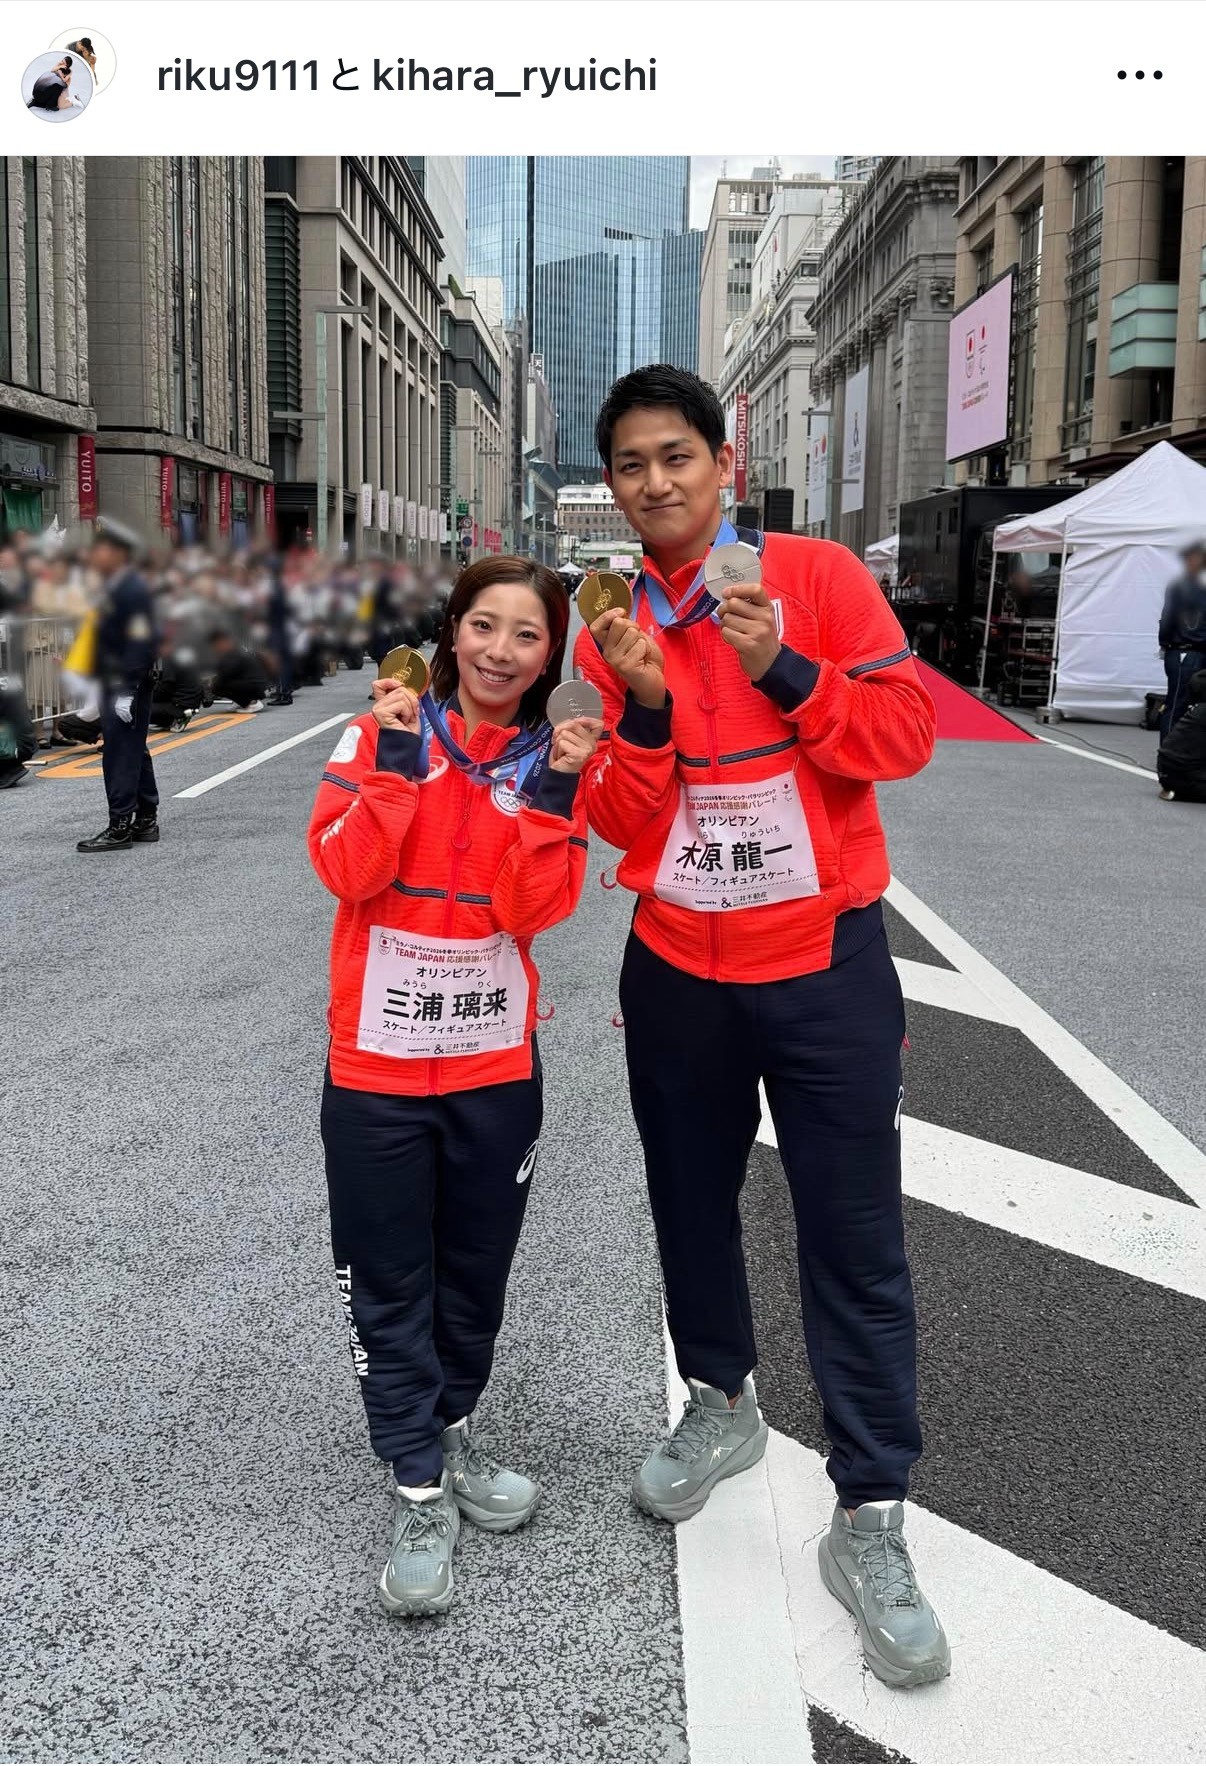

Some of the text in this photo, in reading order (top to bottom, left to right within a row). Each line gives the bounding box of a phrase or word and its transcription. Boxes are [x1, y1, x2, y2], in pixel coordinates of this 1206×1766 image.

[736, 399, 747, 470] MITSUKOSHI
[81, 450, 92, 493] YUITO
[696, 801, 719, 810] JAPAN
[697, 815, 760, 828] オリンピアン
[741, 825, 781, 839] りゅういち
[675, 840, 793, 873] 木原 龍一
[395, 947, 416, 960] TEAM
[417, 952, 445, 963] JAPAN
[416, 966, 487, 979] オリンピアン
[402, 978, 492, 990] みうら りく
[382, 987, 508, 1022] 三浦 璃来
